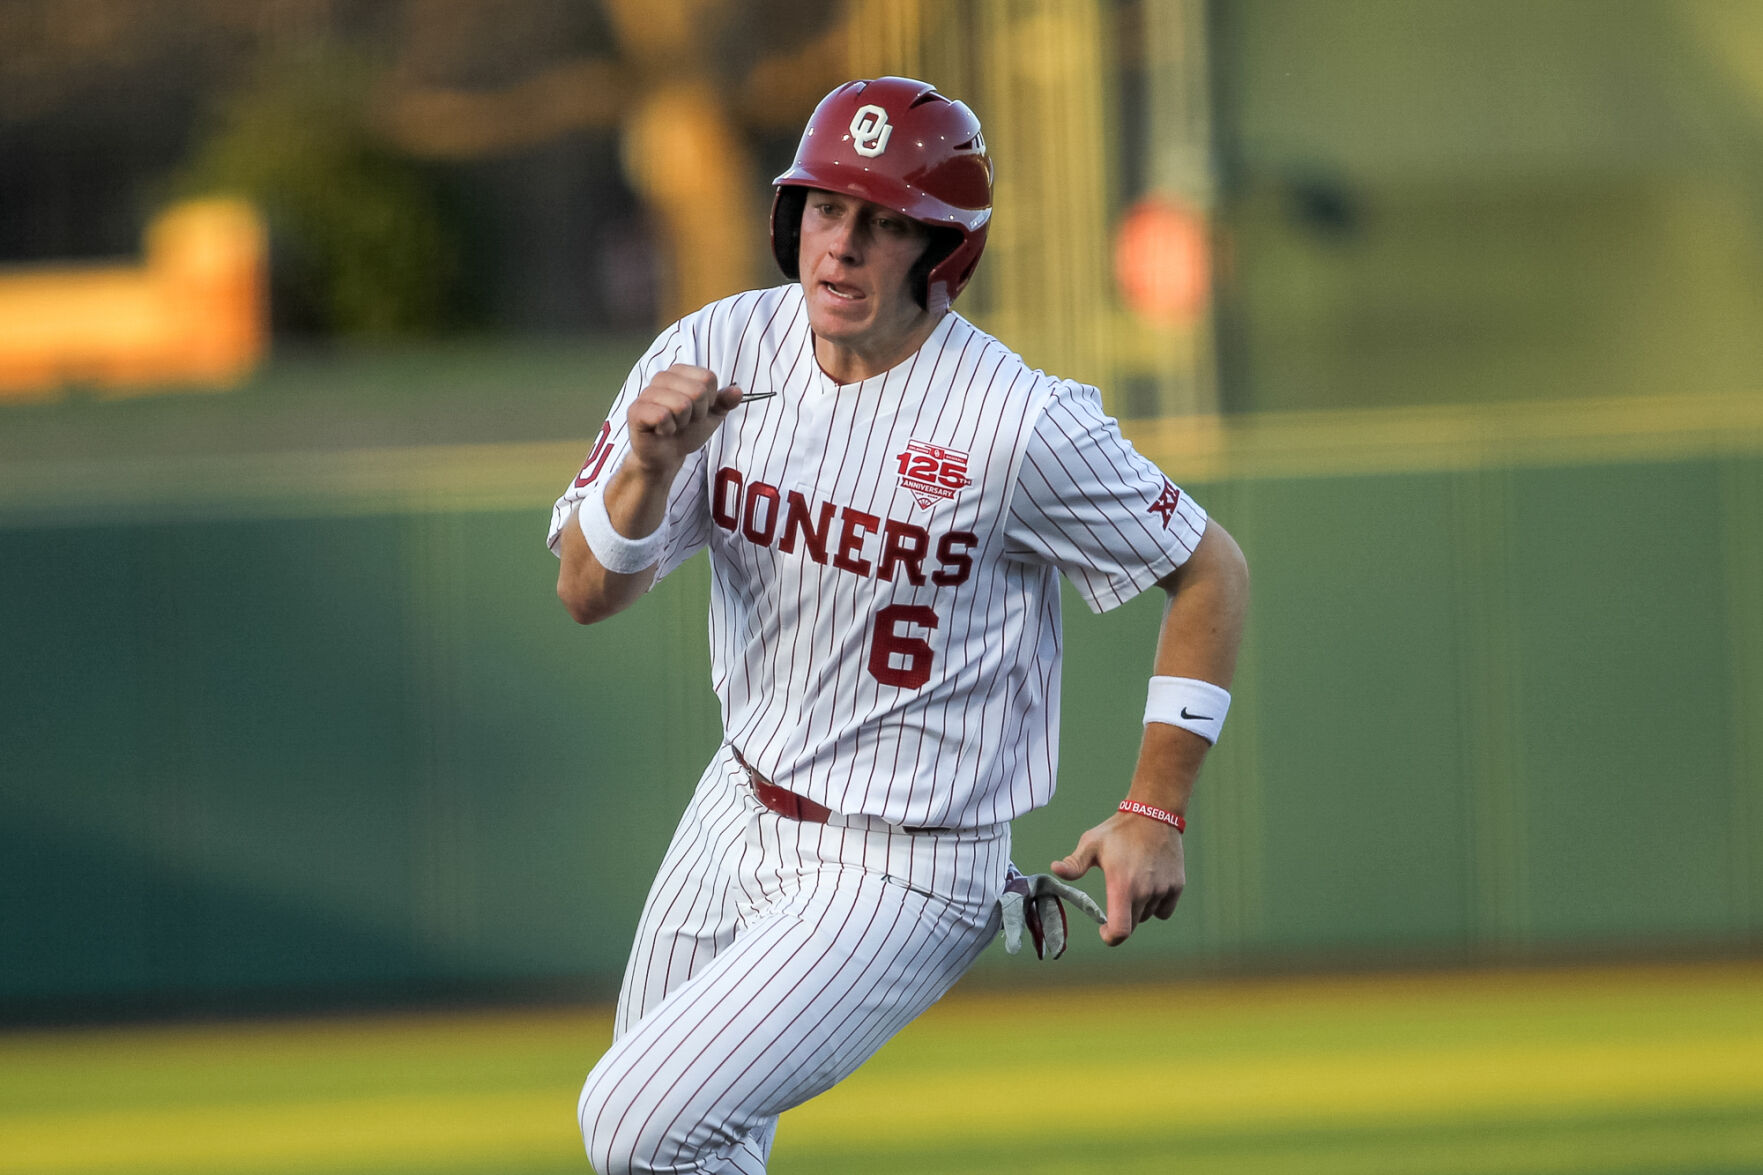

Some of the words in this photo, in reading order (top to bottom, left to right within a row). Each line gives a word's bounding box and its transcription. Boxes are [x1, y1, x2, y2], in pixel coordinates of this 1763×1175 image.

[849, 104, 893, 158] OU
[903, 480, 953, 497] ANNIVERSARY
[867, 603, 940, 691] 6
[1119, 800, 1132, 811] OU
[1132, 802, 1179, 827] BASEBALL
